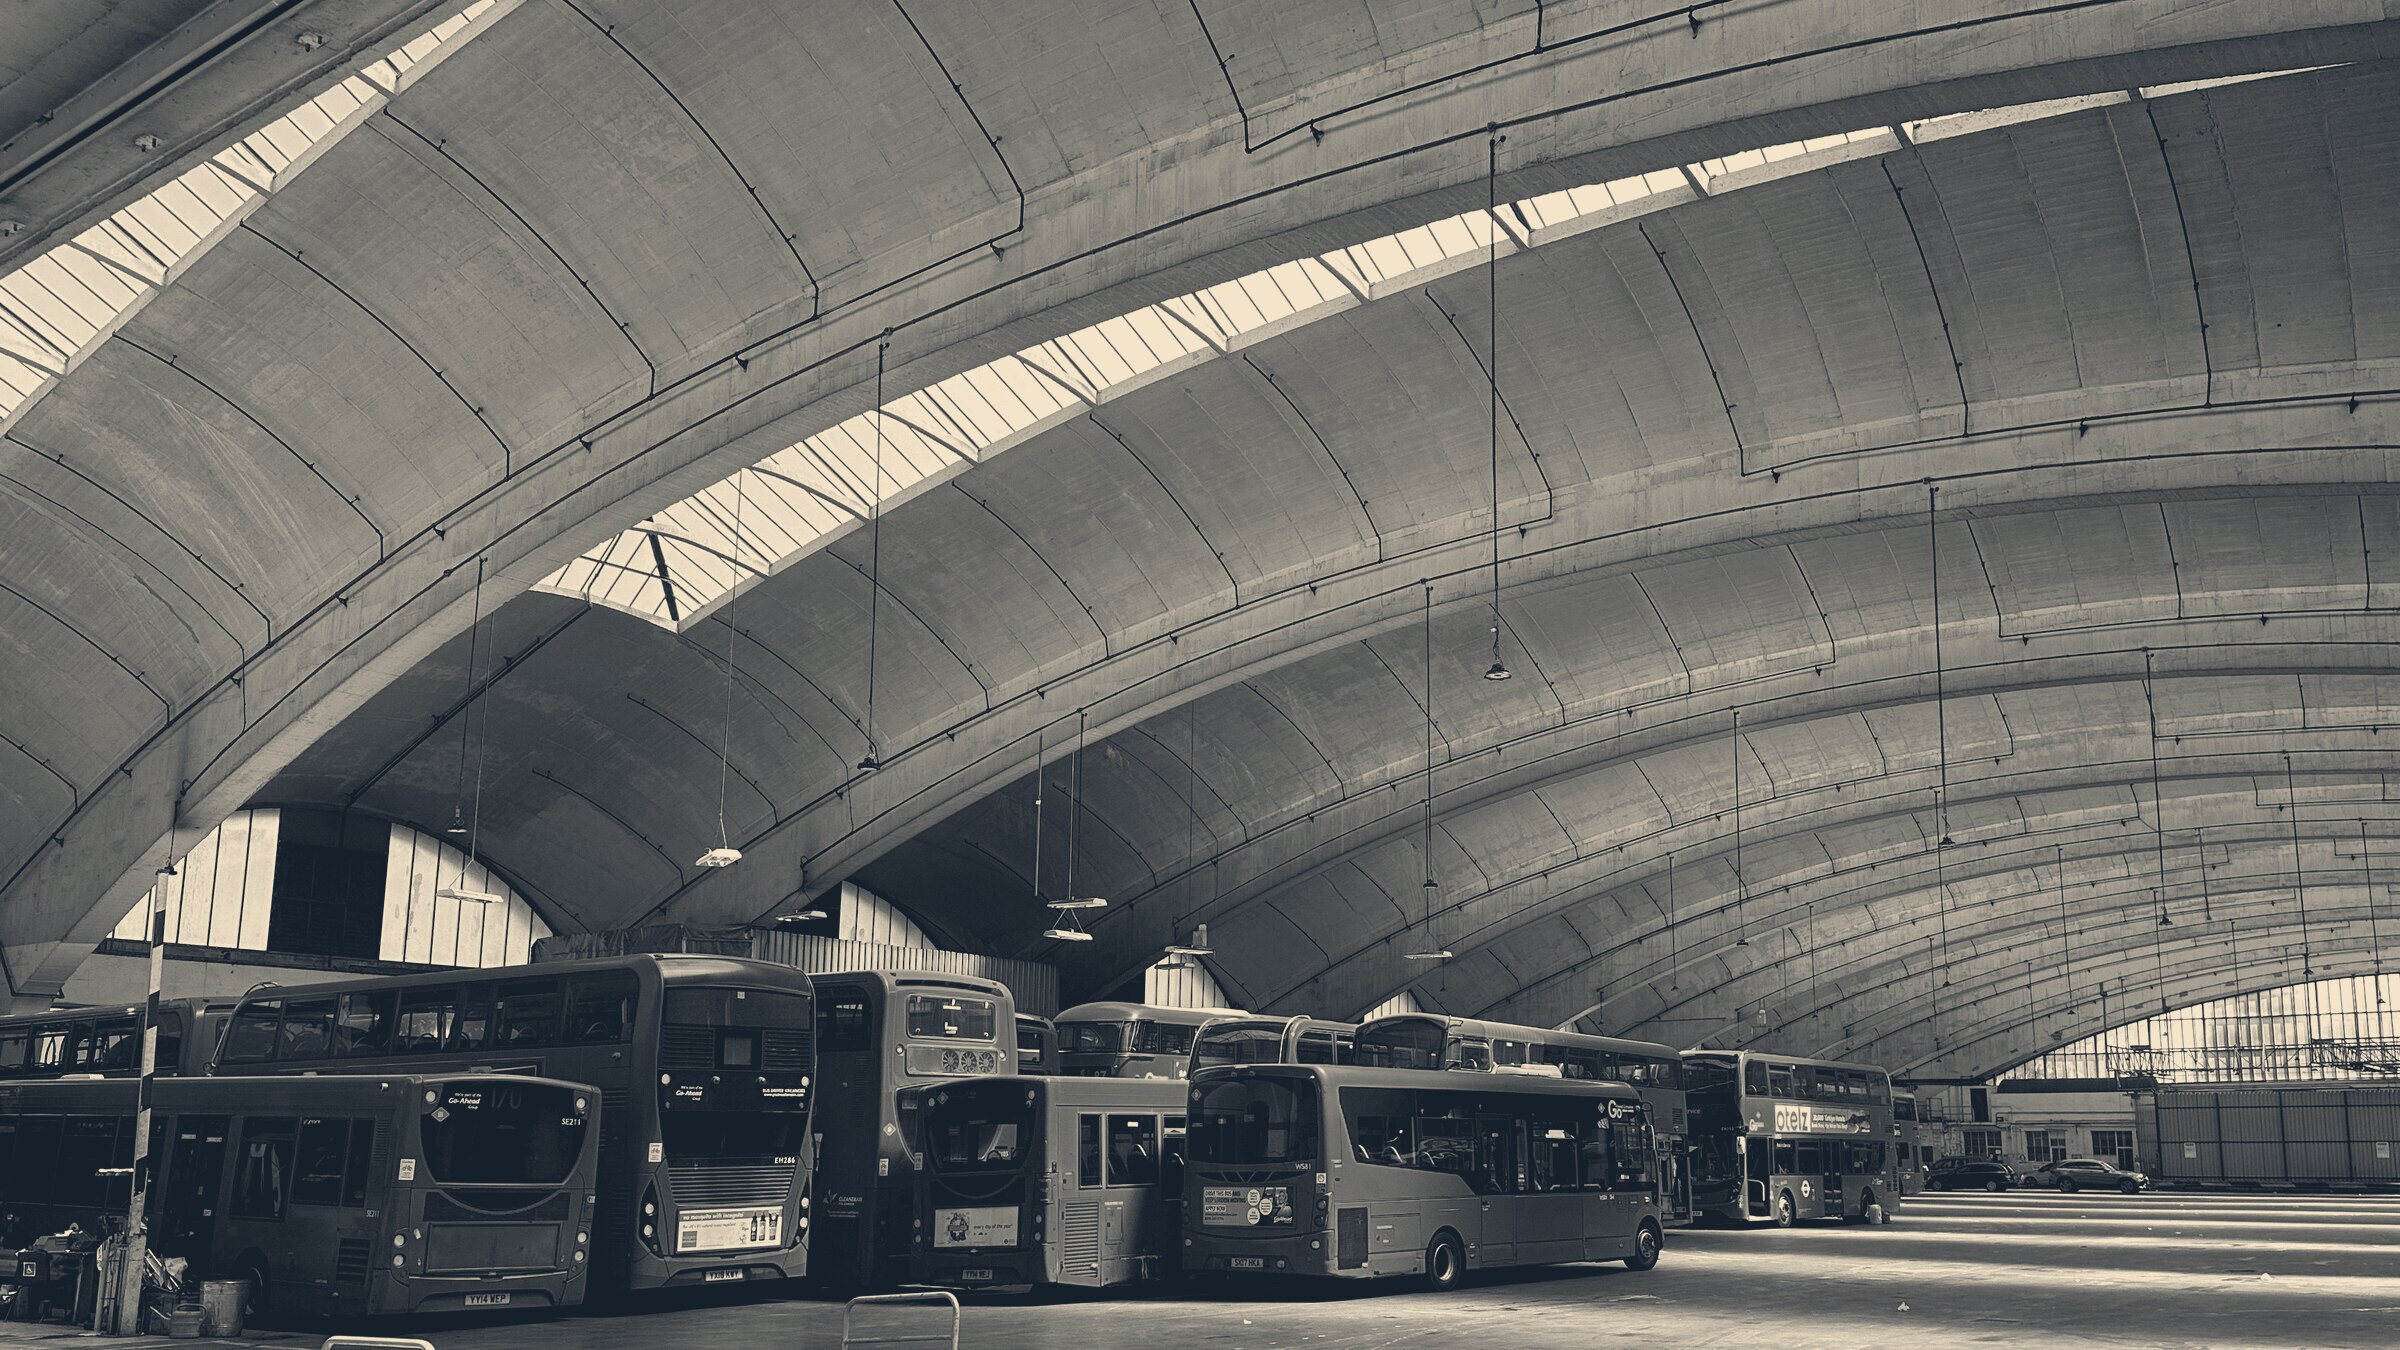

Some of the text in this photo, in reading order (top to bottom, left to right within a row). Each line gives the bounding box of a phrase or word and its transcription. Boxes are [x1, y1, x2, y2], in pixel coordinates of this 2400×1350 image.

[1776, 1107, 1808, 1131] otelz
[471, 1294, 506, 1303] YY14 WEP
